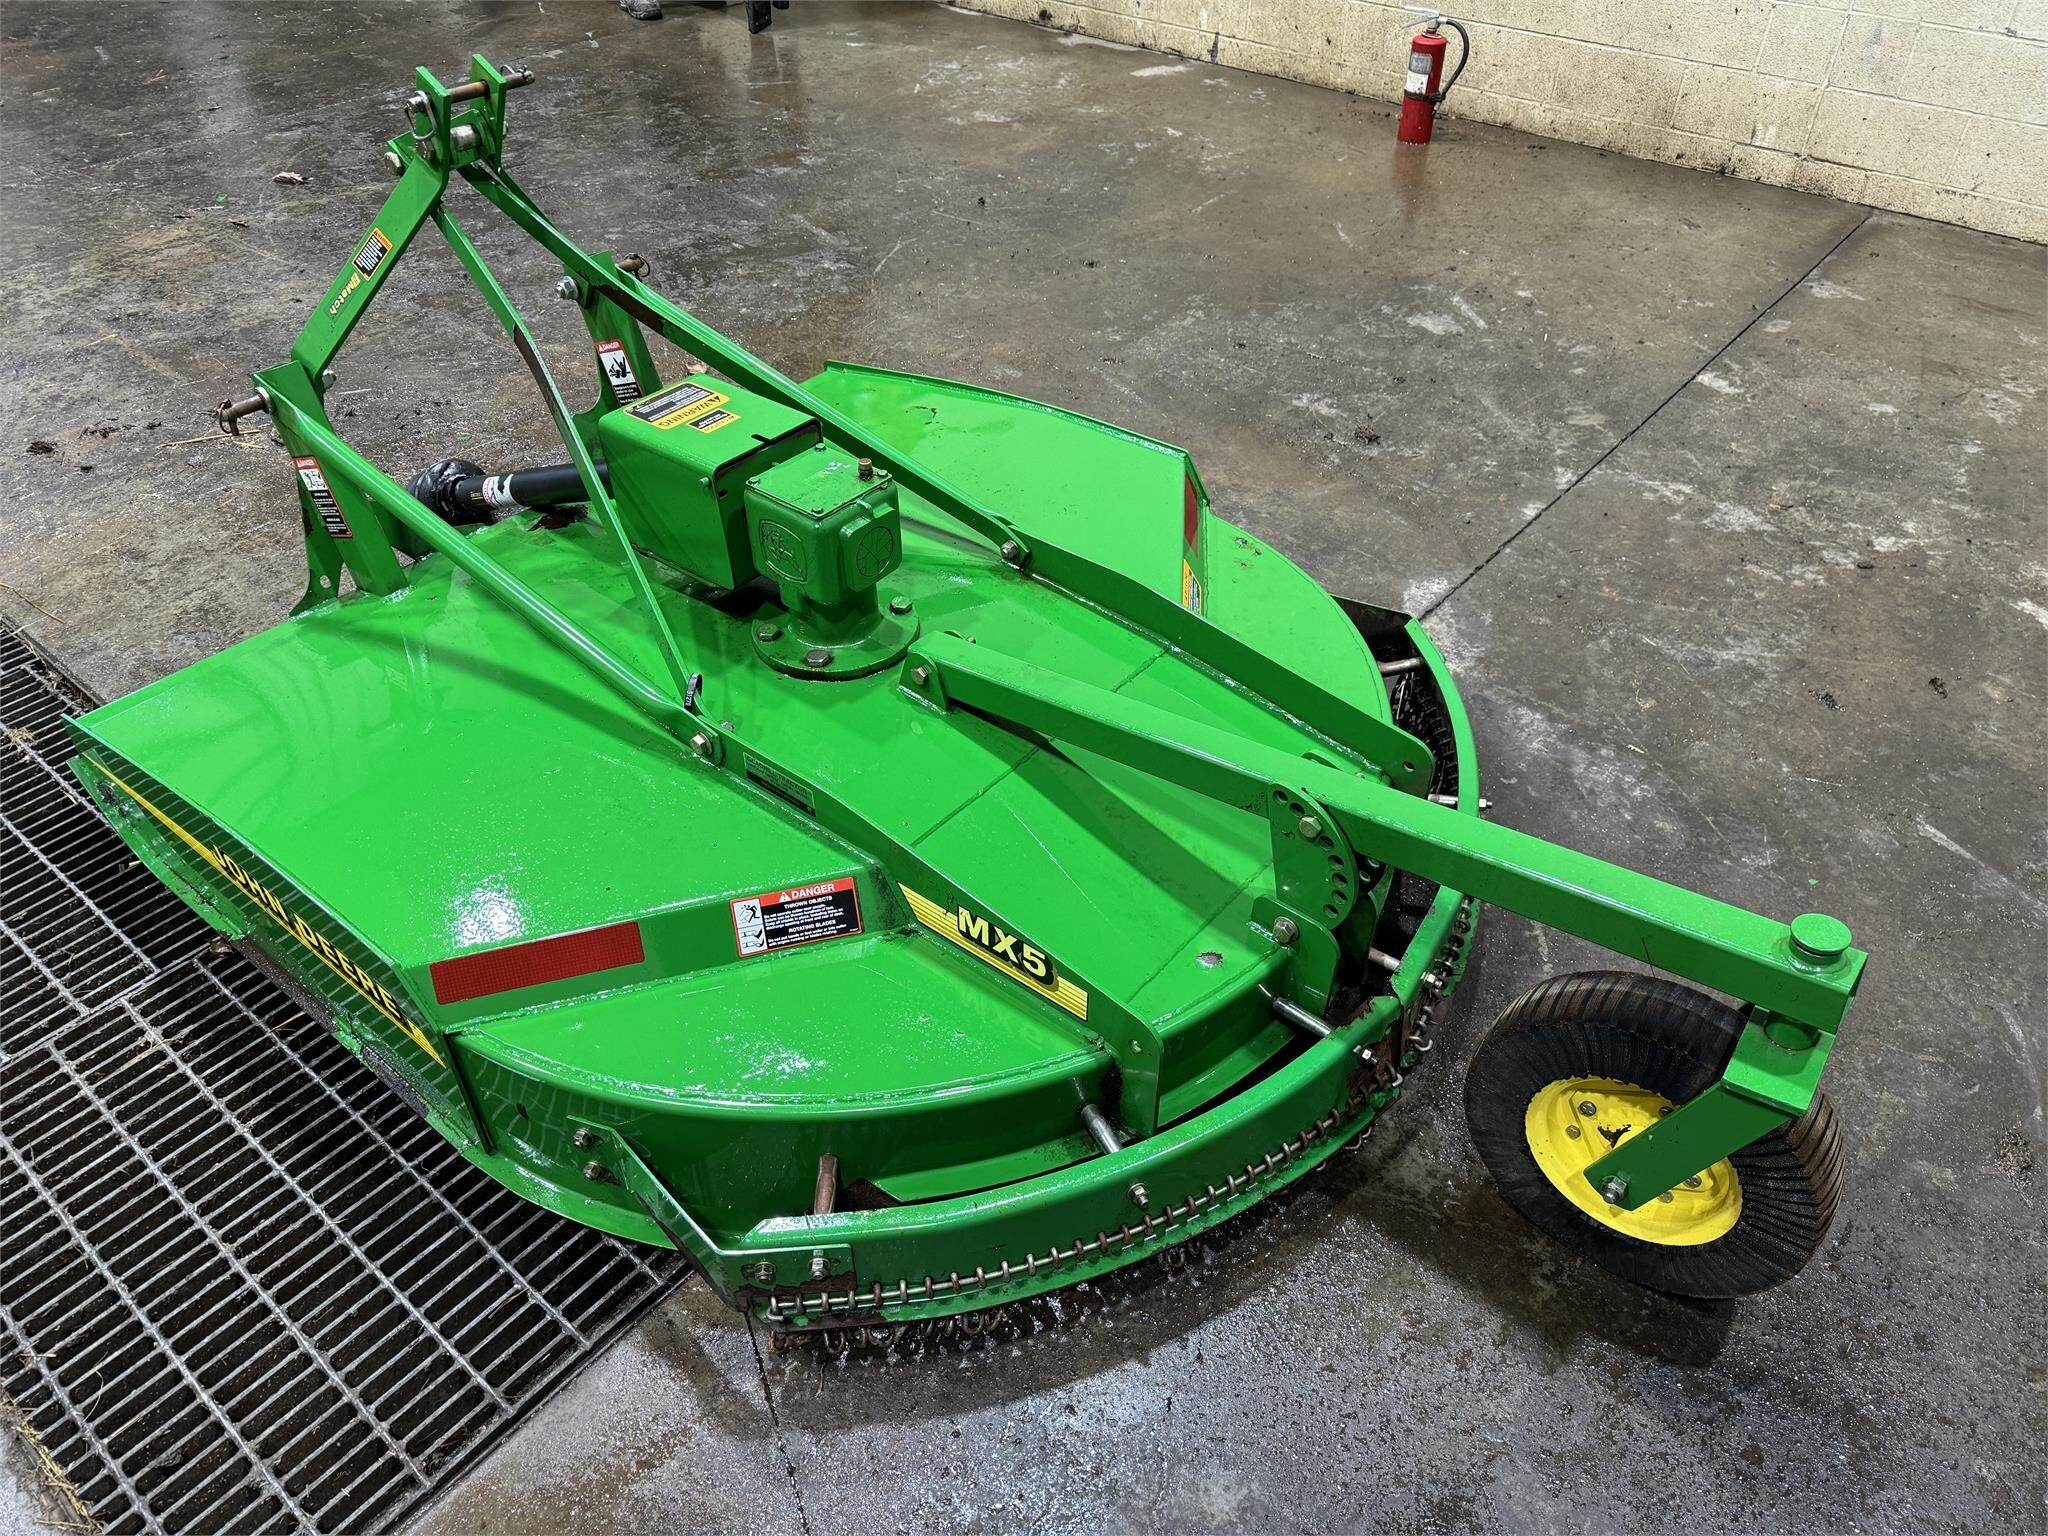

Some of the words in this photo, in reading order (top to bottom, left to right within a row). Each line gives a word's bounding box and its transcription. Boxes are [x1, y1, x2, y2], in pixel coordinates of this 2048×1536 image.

[659, 400, 713, 427] WARNING
[791, 883, 834, 899] DANGER
[784, 900, 807, 909] THROWN
[808, 895, 832, 904] OBJECTS
[213, 844, 289, 922] JOHN
[294, 913, 402, 1019] DEERE
[788, 923, 814, 933] ROTATING
[815, 919, 836, 927] BLADES
[958, 906, 1047, 977] MX5
